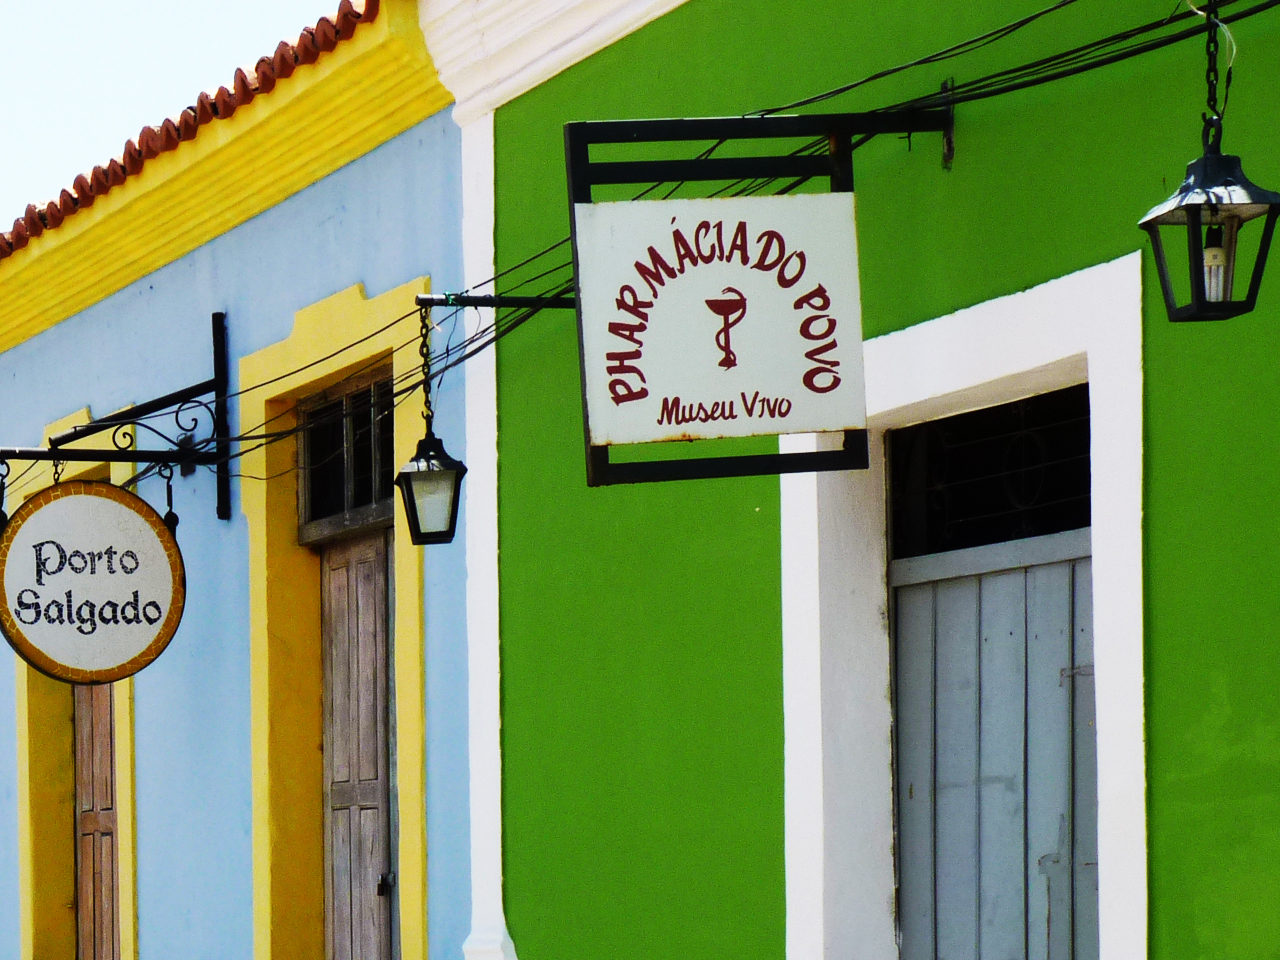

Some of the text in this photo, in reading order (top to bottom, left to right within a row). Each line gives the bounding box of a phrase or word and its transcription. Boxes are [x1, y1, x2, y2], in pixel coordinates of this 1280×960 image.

[606, 216, 842, 406] PHARMÁCIA DO POVO
[656, 396, 738, 426] Museu
[32, 539, 140, 586] Porto
[14, 588, 163, 635] Salgado
